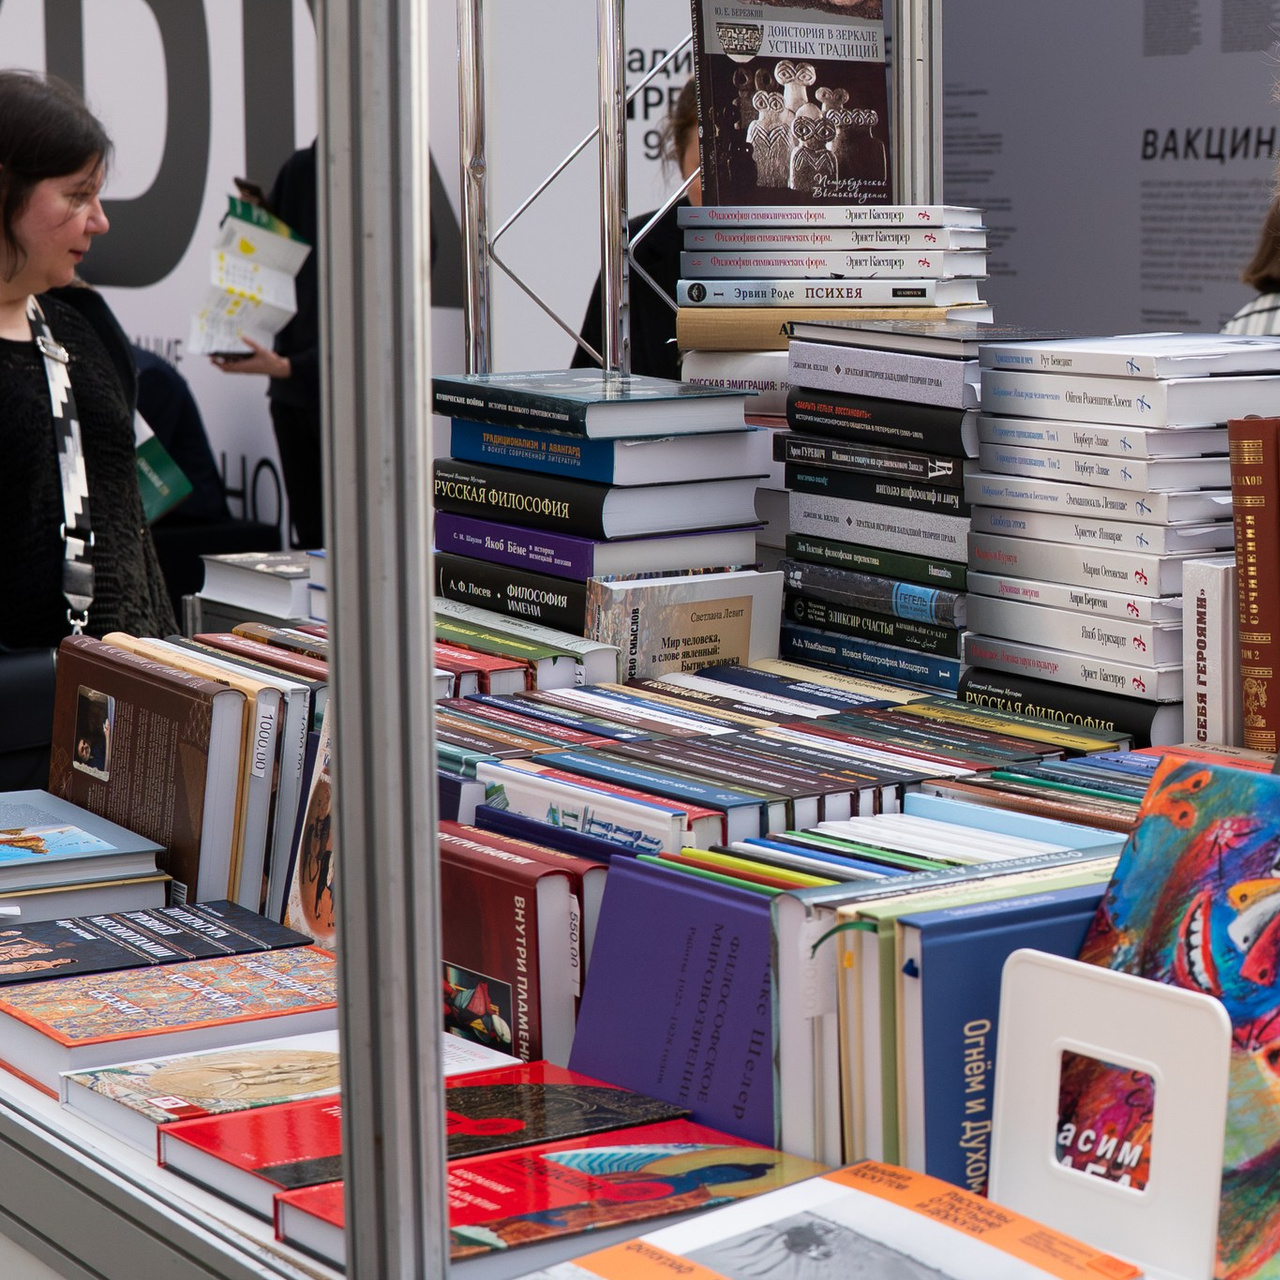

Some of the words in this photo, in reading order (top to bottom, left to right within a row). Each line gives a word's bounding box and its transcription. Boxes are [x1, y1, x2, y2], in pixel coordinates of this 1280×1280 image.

[731, 8, 763, 19] БЕРЕЗКИН
[767, 25, 825, 40] ДОИСТОРИЯ
[827, 28, 834, 39] В
[835, 29, 878, 42] ЗЕРКАЛЕ
[768, 40, 816, 56] УСТНЫХ
[818, 41, 879, 58] ТРАДИЦИЙ
[1141, 126, 1280, 165] ВАКЦИН
[709, 209, 749, 222] Философия
[751, 211, 803, 220] символических
[804, 209, 826, 222] форм.
[845, 208, 867, 222] Эрнст
[869, 208, 904, 222] Кассирер
[714, 231, 756, 244] Философия
[757, 233, 809, 242] символических
[810, 232, 833, 244] форм.
[851, 230, 874, 245] Эрнст
[875, 230, 910, 245] Кассирер
[710, 256, 751, 269] Философия
[753, 258, 804, 267] символических
[805, 256, 827, 269] форм.
[845, 255, 868, 269] Эрнст
[869, 255, 905, 269] Кассирер
[734, 288, 767, 300] Эрвин
[771, 288, 795, 299] Роде
[805, 287, 863, 299] ПСИХЕЯ
[1040, 353, 1051, 368] Рут
[1050, 354, 1072, 367] Бенедикт
[727, 379, 778, 391] ЭМИГРАЦИЯ:
[844, 367, 864, 377] КРАТКАЯ
[864, 369, 884, 380] ИСТОРИЯ
[884, 371, 909, 384] ЗАПАДНОЙ
[927, 377, 943, 388] ПРАВА
[466, 397, 485, 408] ВОЙНЫ
[507, 404, 530, 416] ВЕЛИКОГО
[1065, 391, 1083, 404] Ойген
[1083, 392, 1133, 409] Розеншток-Хюсси
[482, 432, 539, 451] ТРАДИЦИОНАЛИЗМ
[541, 443, 546, 451] И
[548, 441, 581, 458] АВАНГАРД
[1073, 431, 1094, 448] Норберт
[1094, 434, 1109, 447] Элиас
[487, 445, 507, 455] ФОКУСЕ
[508, 448, 546, 461] СОВРЕМЕННОЙ
[547, 454, 581, 467] ЛИТЕРАТУРЫ
[801, 447, 825, 459] ГУРЕВИЧ
[855, 455, 870, 467] социум
[1074, 460, 1094, 477] Норберт
[1095, 462, 1110, 476] Элиас
[875, 483, 900, 497] сегодня
[1236, 475, 1263, 487] МАХОВ
[434, 479, 487, 504] РУССКАЯ
[488, 488, 570, 519] ФИЛОСОФИЯ
[900, 486, 937, 504] философия
[943, 495, 959, 509] Кант
[1101, 496, 1128, 511] Левинас
[856, 519, 876, 530] КРАТКАЯ
[875, 522, 897, 534] ИСТОРИЯ
[897, 524, 922, 538] ЗАПАДНОЙ
[922, 529, 941, 540] ТЕОРИИ
[941, 532, 957, 544] ПРАВА
[1074, 524, 1097, 540] Христос
[1098, 527, 1123, 544] Яннарас
[484, 536, 506, 552] Якоб
[507, 540, 527, 557] Бёме
[1082, 561, 1100, 578] Мария
[1100, 565, 1129, 580] Оссовская
[1245, 515, 1260, 625] СОЧИНЕНИЯ
[458, 580, 468, 593] Ф.
[468, 582, 492, 598] Лосев
[506, 584, 568, 609] ФИЛОСОФИЯ
[1069, 590, 1084, 606] Анри
[1084, 592, 1108, 609] Бергсон
[507, 599, 542, 618] ИМЕНИ
[690, 609, 723, 624] Светлана
[723, 607, 745, 620] Левит
[629, 607, 640, 657] смыслов
[828, 609, 861, 629] ЭЛИКСИР
[861, 617, 894, 636] СЧАСТЬЯ
[661, 636, 680, 651] Мир
[681, 633, 721, 648] человека,
[1081, 625, 1097, 640] Якоб
[1097, 628, 1127, 647] Буркхардт
[1196, 588, 1208, 685] ГЕРОЯМИ»
[652, 655, 657, 663] в
[658, 651, 680, 662] слове
[681, 645, 720, 660] явленный:
[681, 659, 706, 672] Бытие
[707, 655, 740, 669] человека
[803, 640, 837, 655] Улыбышев
[841, 648, 862, 660] Новая
[862, 652, 898, 668] биография
[899, 659, 929, 675] Моцарта
[1241, 649, 1253, 660] ТОМ
[1254, 650, 1260, 660] 2
[1080, 664, 1098, 681] Эрнст
[1098, 667, 1126, 688] Кассирер
[965, 691, 1022, 715] РУССКАЯ
[1024, 703, 1115, 733] ФИЛОСОФИЯ
[1196, 688, 1209, 742] СЕБЯ
[254, 713, 275, 772] 1000.00
[160, 907, 230, 940] ЛИТЕРАТУРА
[513, 894, 530, 971] ВНУТРИ
[88, 915, 178, 959] МЕСОПОТАМИИ
[569, 910, 580, 969] 550.00
[165, 972, 245, 1008] КЕЛЬТСКИЕ
[87, 988, 149, 1017] СКАЗКИ
[677, 922, 726, 1105] МИРОВОЗЗРЕНИЕ
[698, 934, 741, 1104] ФИЛОСОФСКОЕ
[962, 1018, 992, 1094] Огнём
[732, 1027, 767, 1122] Шелер
[964, 1097, 987, 1115] и
